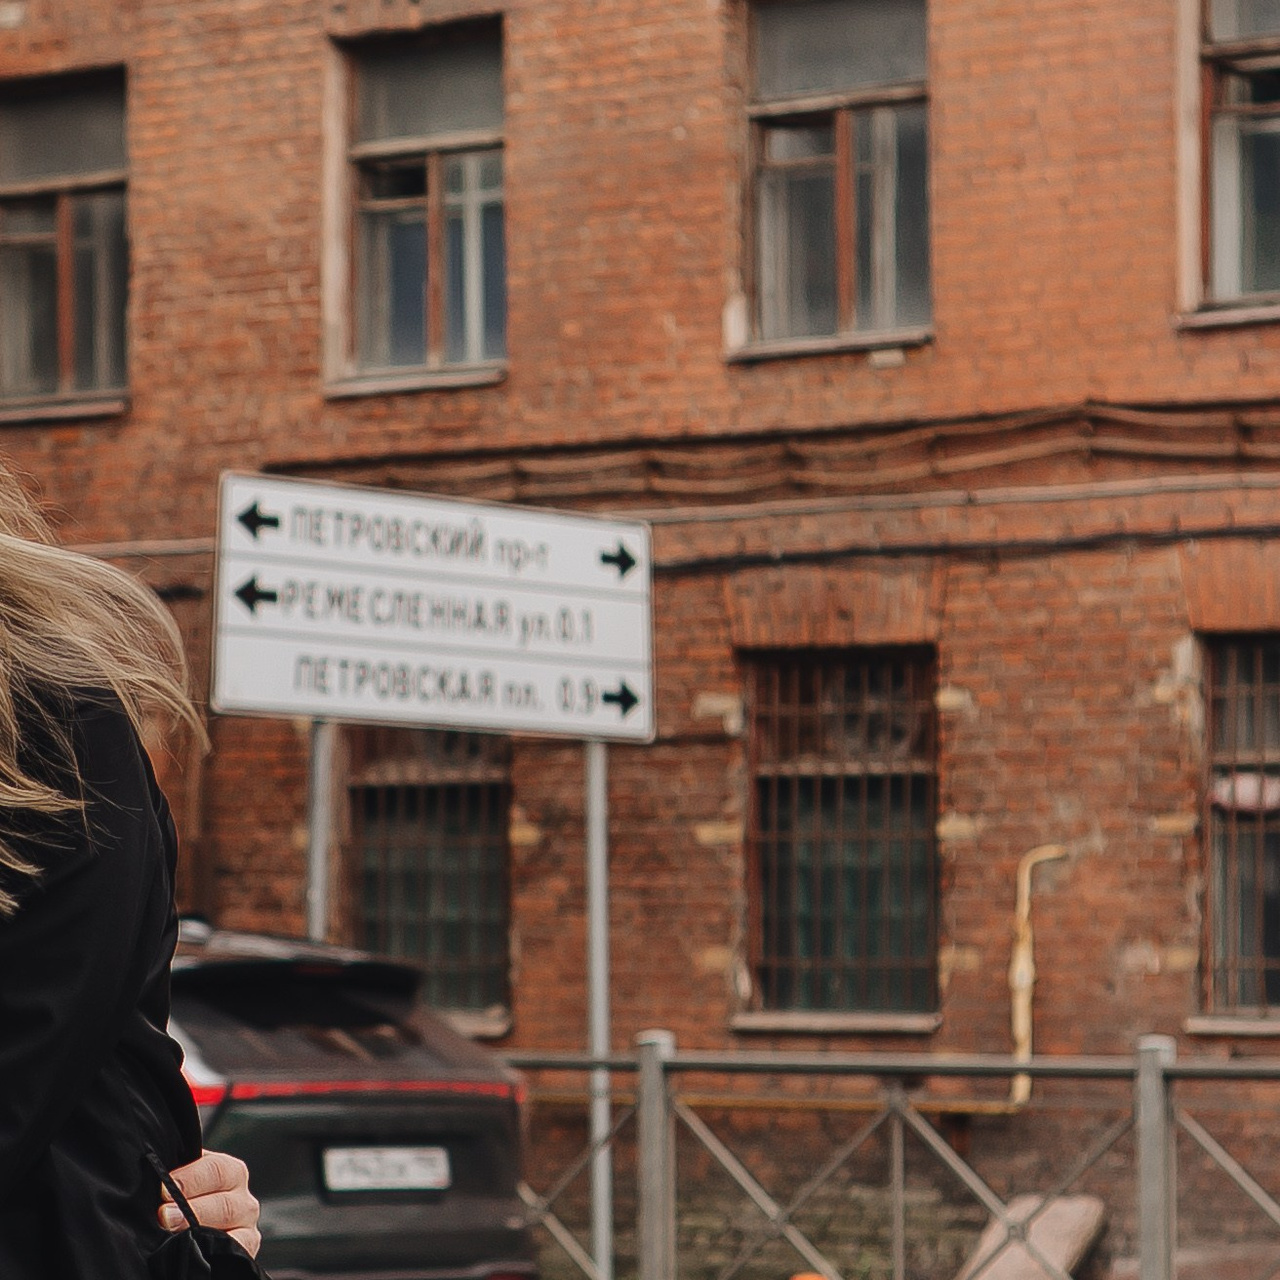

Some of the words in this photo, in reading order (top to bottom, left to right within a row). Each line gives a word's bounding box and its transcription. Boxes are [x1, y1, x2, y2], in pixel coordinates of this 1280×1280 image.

[289, 504, 486, 560] ПЕТРОВСКИЙ
[282, 578, 512, 637] РЕМЕСЛЕННАЯ
[293, 654, 496, 707] ПЕТРОВСКАЯ
